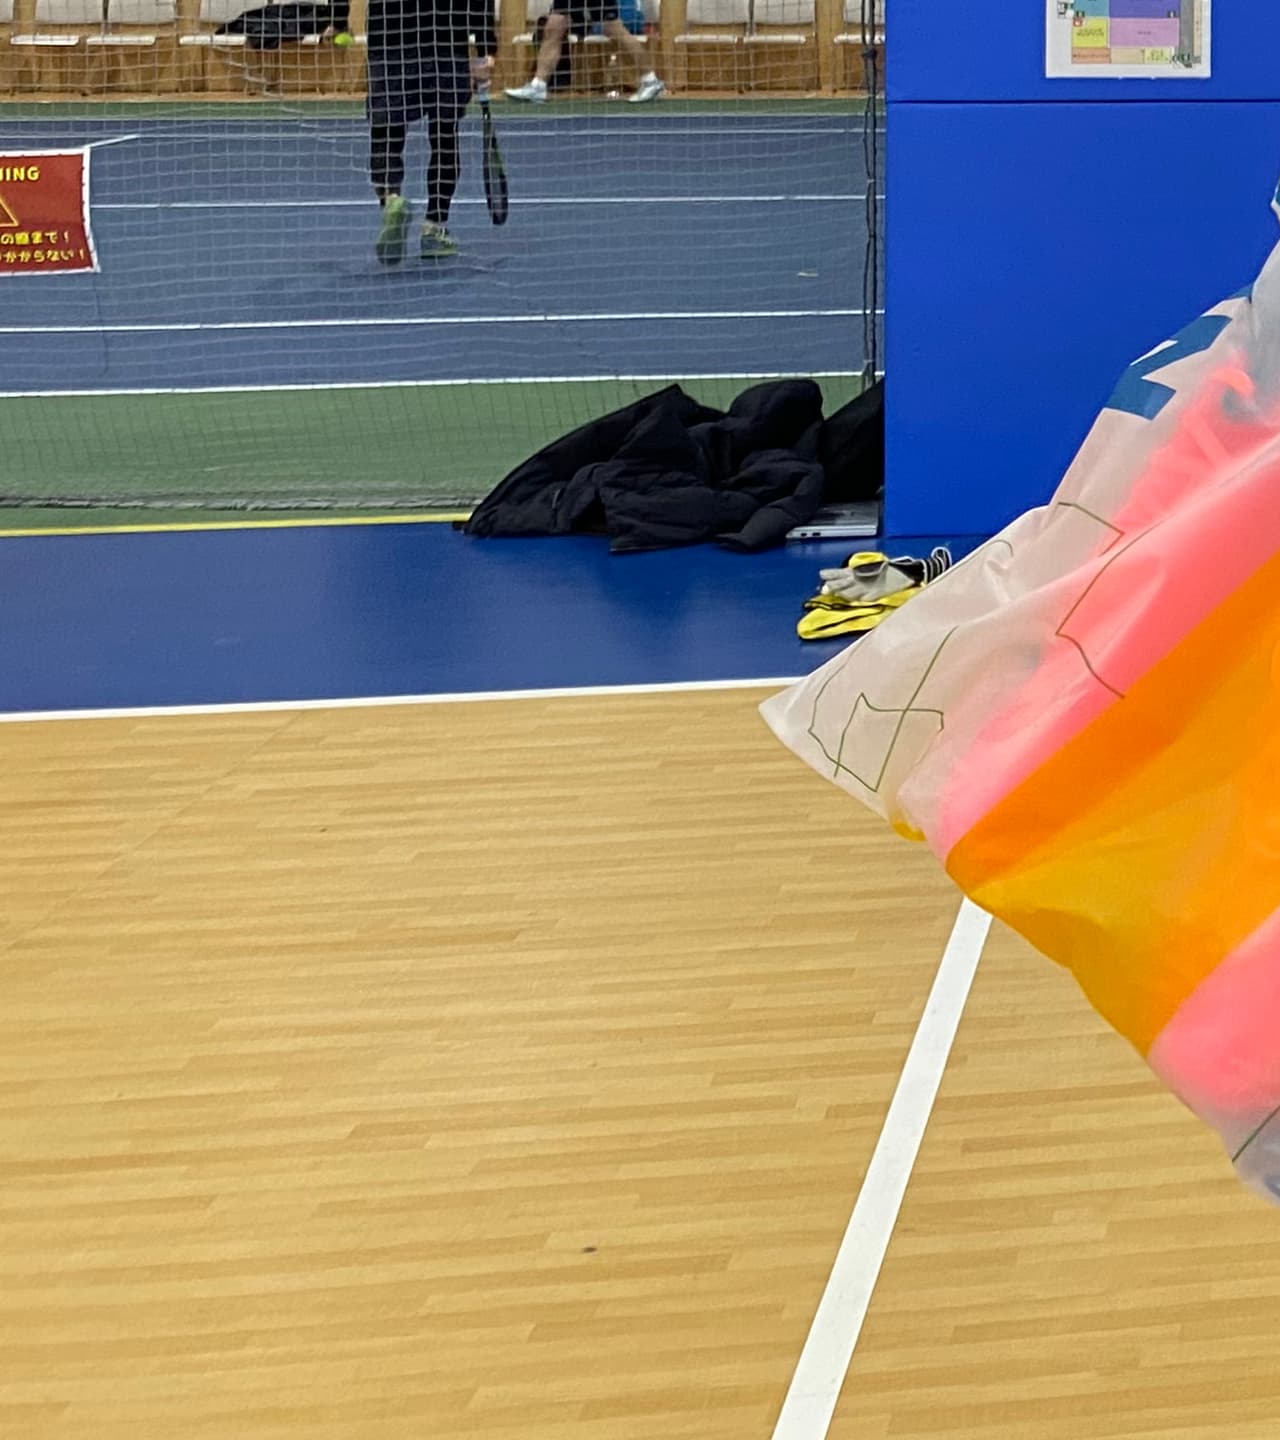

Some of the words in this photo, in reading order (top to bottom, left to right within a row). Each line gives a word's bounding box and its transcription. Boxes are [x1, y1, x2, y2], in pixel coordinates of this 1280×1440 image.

[0, 248, 85, 263] かからない！
